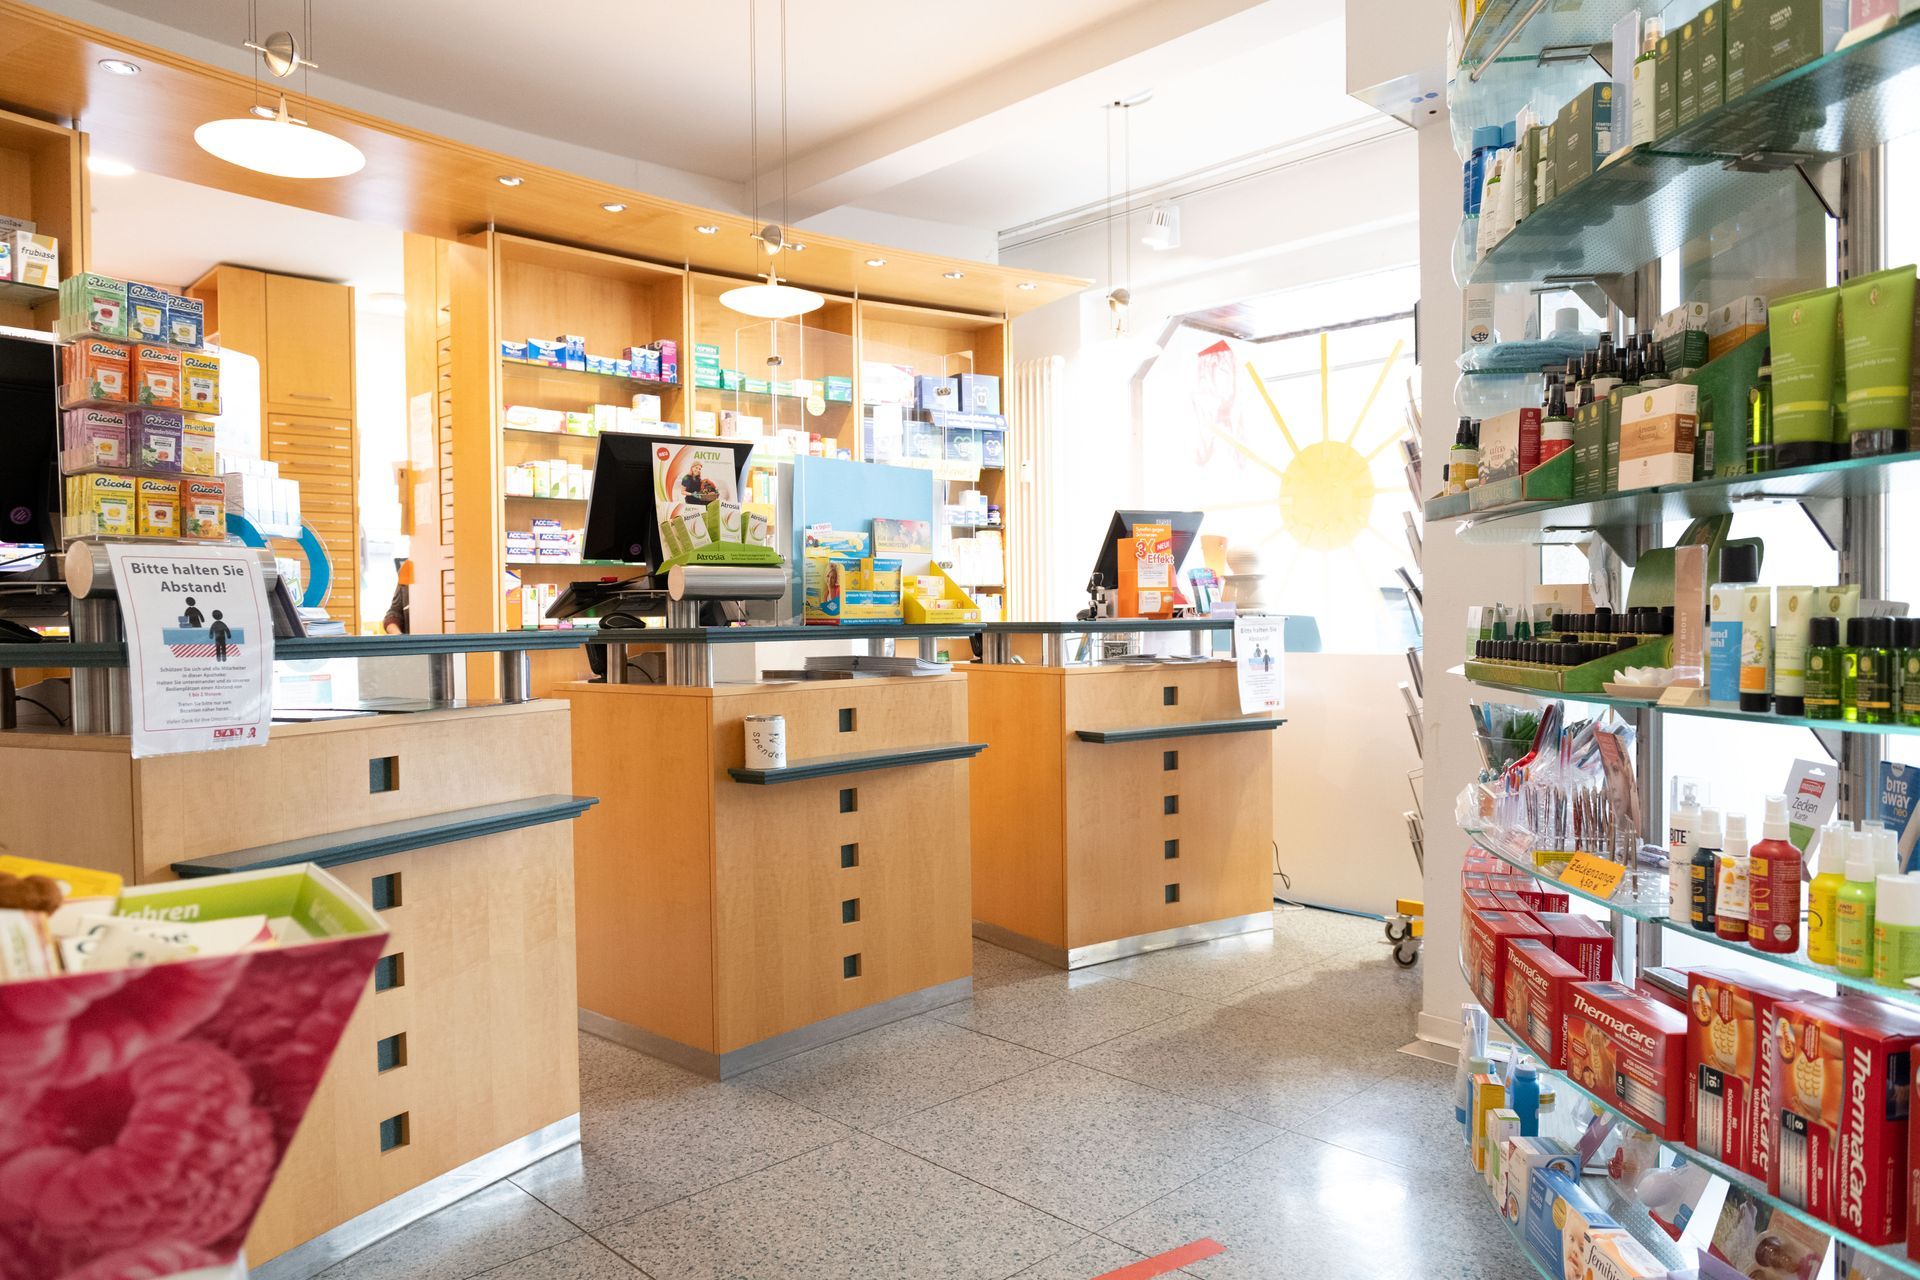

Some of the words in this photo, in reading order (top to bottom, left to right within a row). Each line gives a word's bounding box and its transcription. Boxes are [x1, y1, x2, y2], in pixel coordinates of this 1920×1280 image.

[21, 246, 56, 260] frubiase
[87, 276, 125, 292] Ricola
[131, 286, 167, 301] Ricola
[168, 296, 201, 312] Ricola
[92, 343, 128, 358] Ricola
[141, 349, 178, 362] Ricola
[185, 357, 218, 370] Ricola
[88, 412, 123, 425] Ricola
[145, 415, 182, 428] Ricola
[184, 423, 215, 433] m-eukal
[693, 451, 720, 460] AKTIV
[95, 478, 132, 490] Ricola
[141, 481, 177, 492] Ricola
[190, 484, 222, 495] Ricola
[720, 502, 740, 510] Atrosia
[684, 512, 701, 521] Atrosia
[751, 514, 768, 523] Atrosia
[1156, 541, 1170, 550] NEU!
[696, 553, 726, 561] Atrosia
[1148, 554, 1174, 564] Effekt
[131, 562, 168, 574] Bitte
[172, 563, 219, 576] halten
[224, 565, 244, 576] Sie
[161, 581, 227, 593] Abstand!
[752, 731, 784, 759] Spende
[1792, 797, 1818, 814] Zecken
[1882, 791, 1910, 809] away
[1794, 812, 1809, 821] Karte
[1670, 828, 1687, 844] BITE
[1569, 859, 1616, 888] Zeckenzange
[116, 901, 199, 923] ahren
[1507, 947, 1548, 989] ThermaCare
[1573, 993, 1656, 1050] ThermaCare
[1560, 1014, 1568, 1066] ThermaCare
[1617, 1075, 1623, 1085] 8
[1708, 1075, 1717, 1087] 16
[1759, 1007, 1772, 1173] ThermaCare
[1751, 1088, 1759, 1164] WÄRMEUMSCHLÄGE
[1794, 1119, 1803, 1130] 8
[1848, 1046, 1872, 1228] ThermaCare
[1810, 1135, 1818, 1206] RÜCKENSCHMERZEN
[1840, 1133, 1849, 1218] WÄRMEUMSCHLÄGE
[1586, 1245, 1620, 1280] femibi
